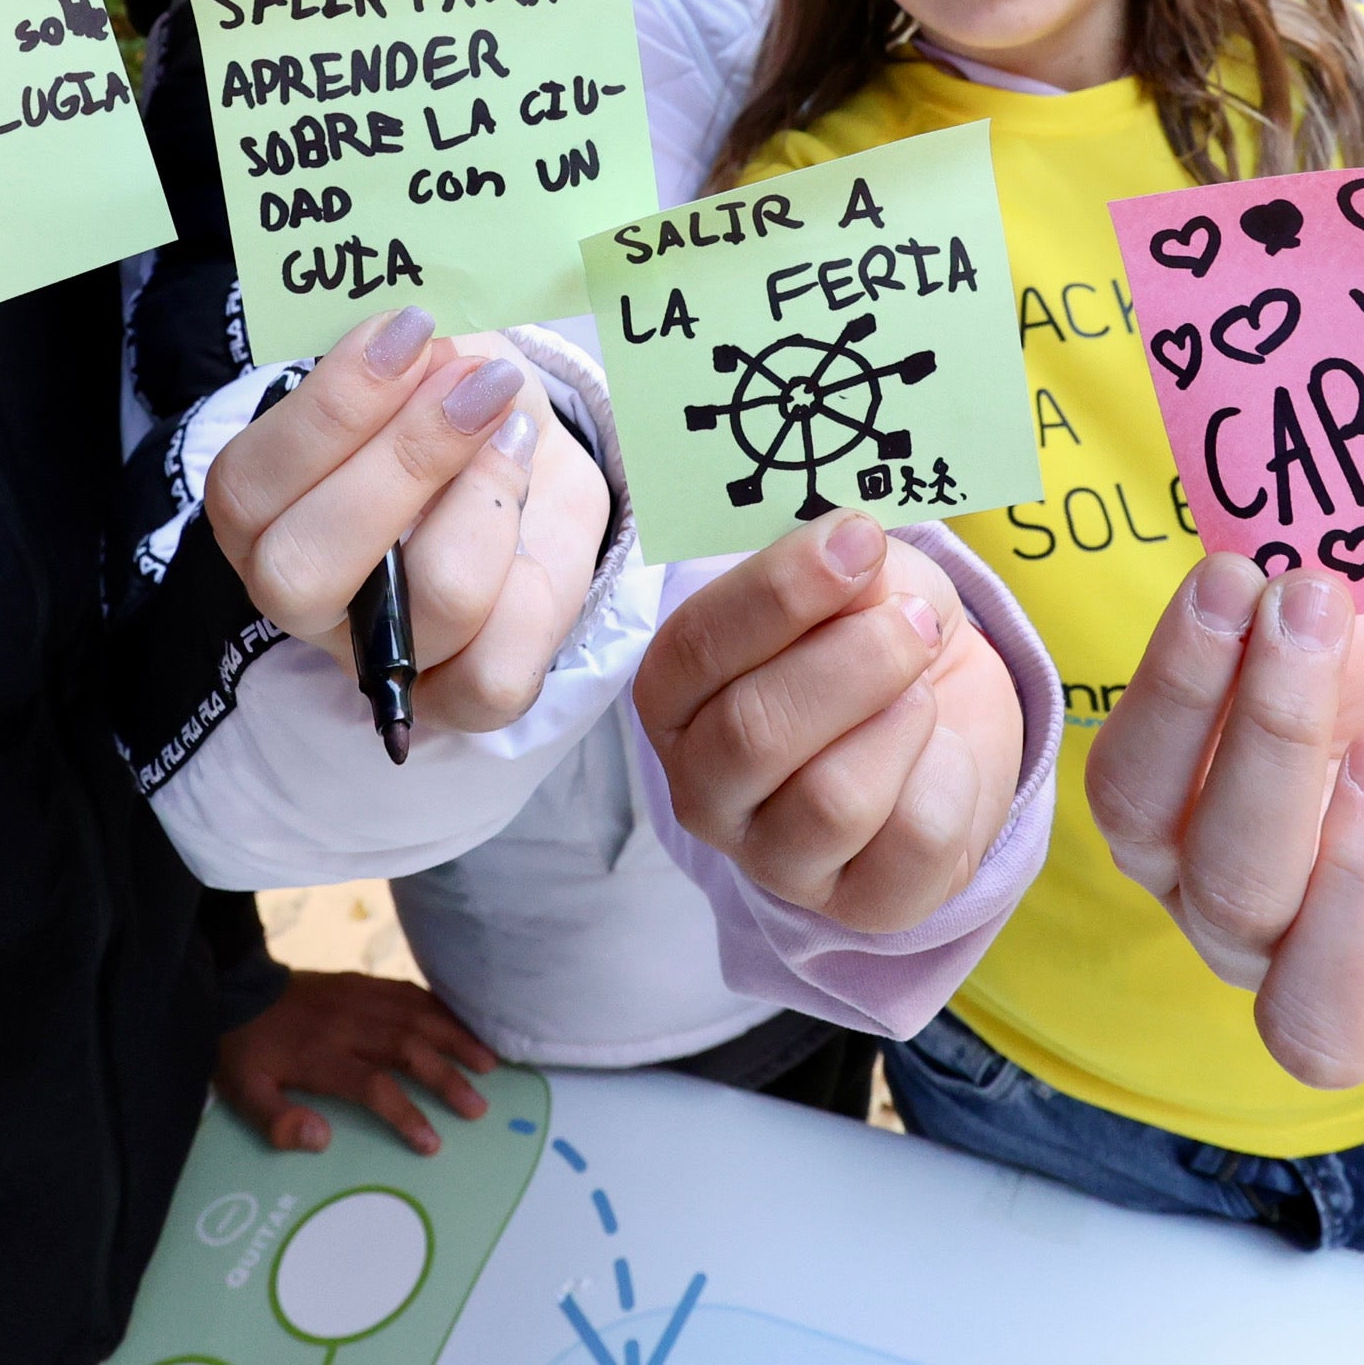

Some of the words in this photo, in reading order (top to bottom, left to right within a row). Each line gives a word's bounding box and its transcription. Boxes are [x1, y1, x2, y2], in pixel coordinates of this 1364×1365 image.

[221, 29, 511, 110] APRENDER
[239, 110, 404, 178] SOBRE
[424, 97, 497, 151] LA
[259, 186, 353, 233] DAD
[535, 139, 601, 193] UN
[614, 194, 805, 265] SALIR
[837, 177, 885, 229] A
[620, 287, 700, 344] LA
[765, 236, 978, 322] FERIA
[239, 616, 286, 654] FIL
